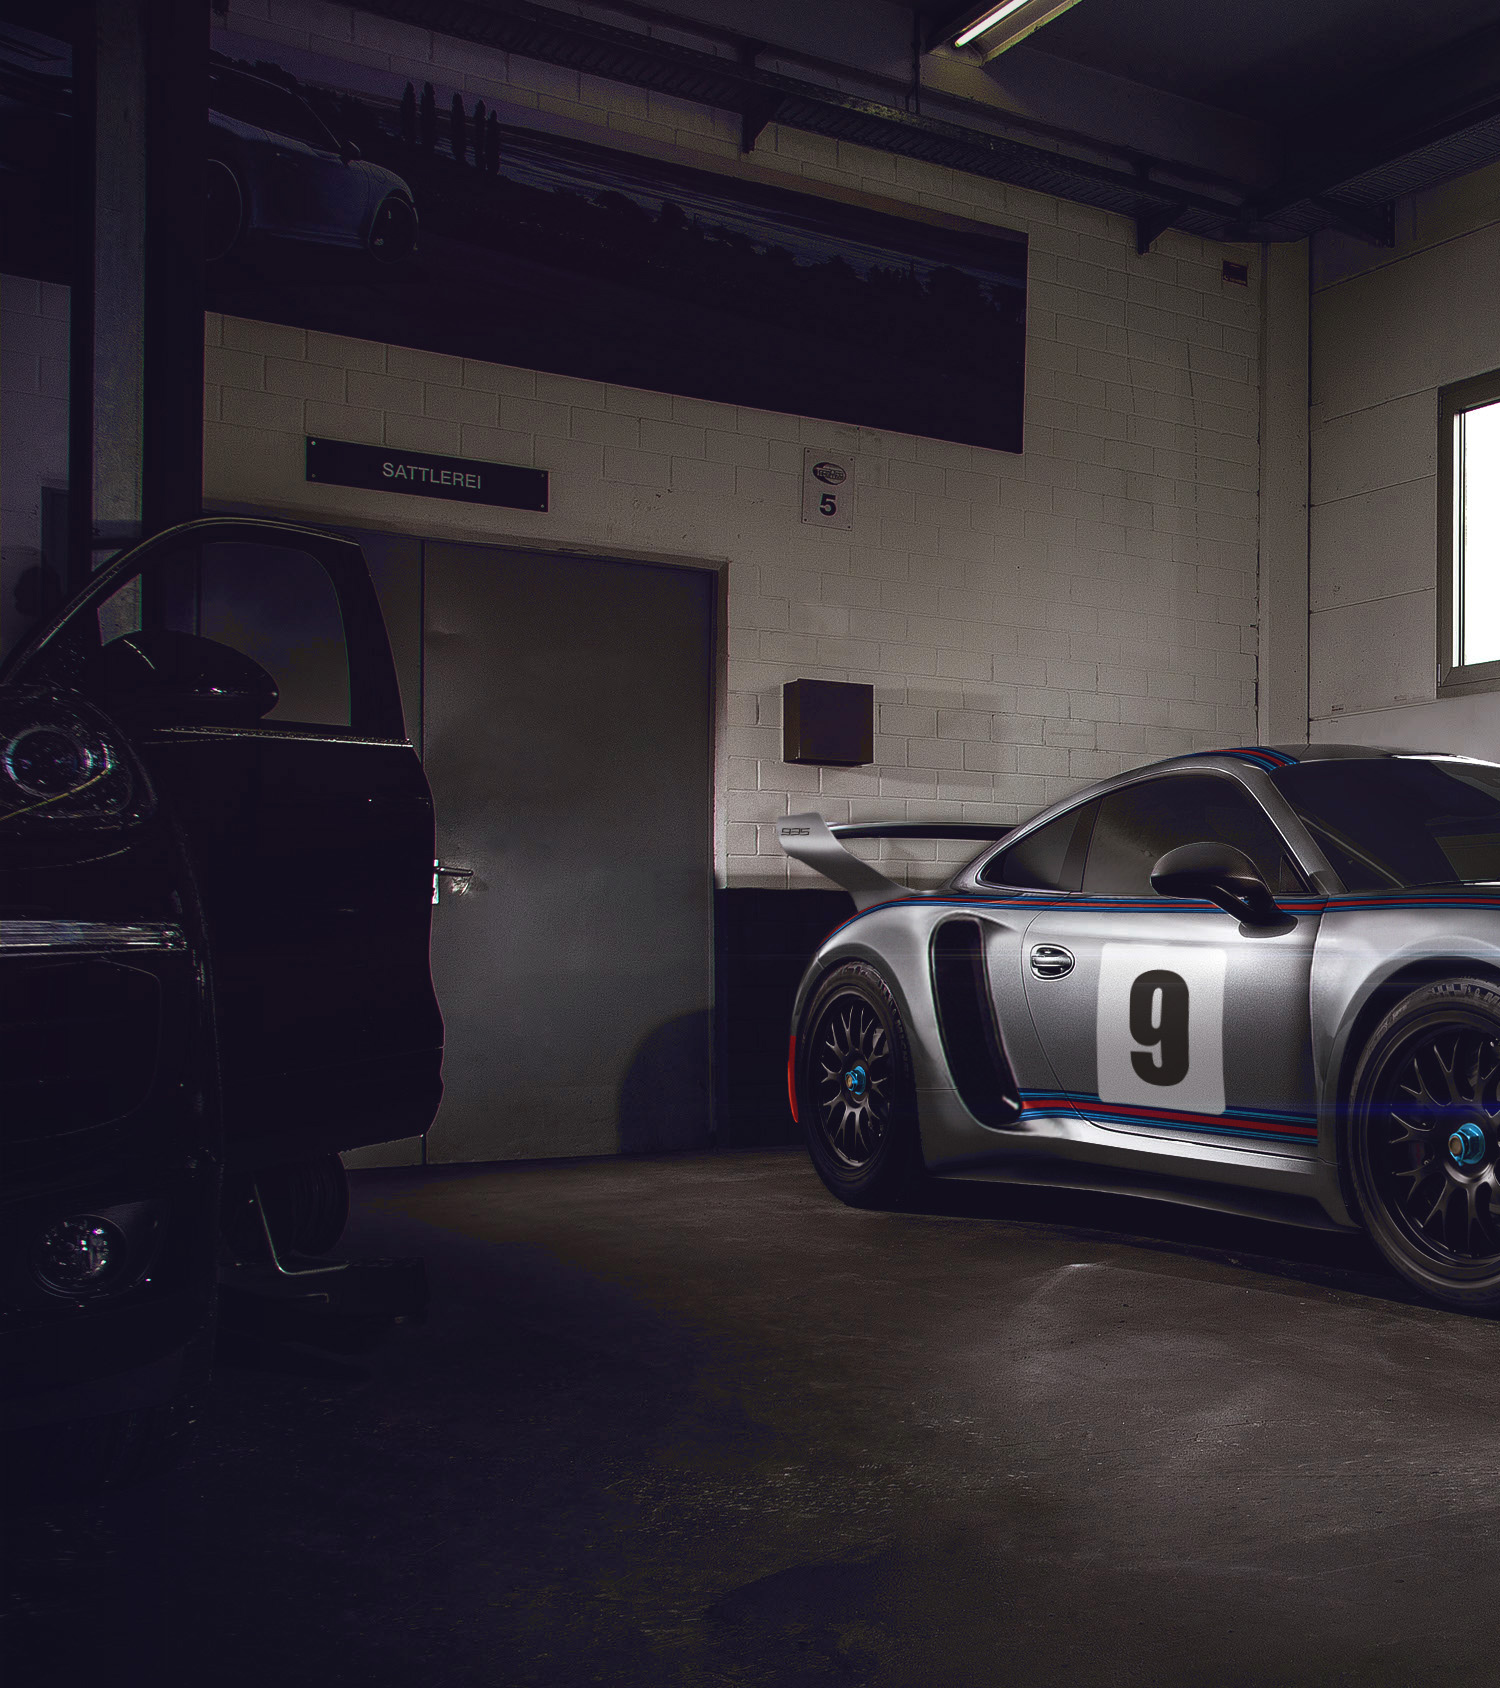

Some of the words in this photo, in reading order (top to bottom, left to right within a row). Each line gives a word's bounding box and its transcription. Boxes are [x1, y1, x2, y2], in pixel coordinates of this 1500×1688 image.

[382, 462, 481, 489] SATTLEREI
[820, 493, 837, 516] 5
[781, 827, 811, 837] 935
[1129, 969, 1190, 1087] 9
